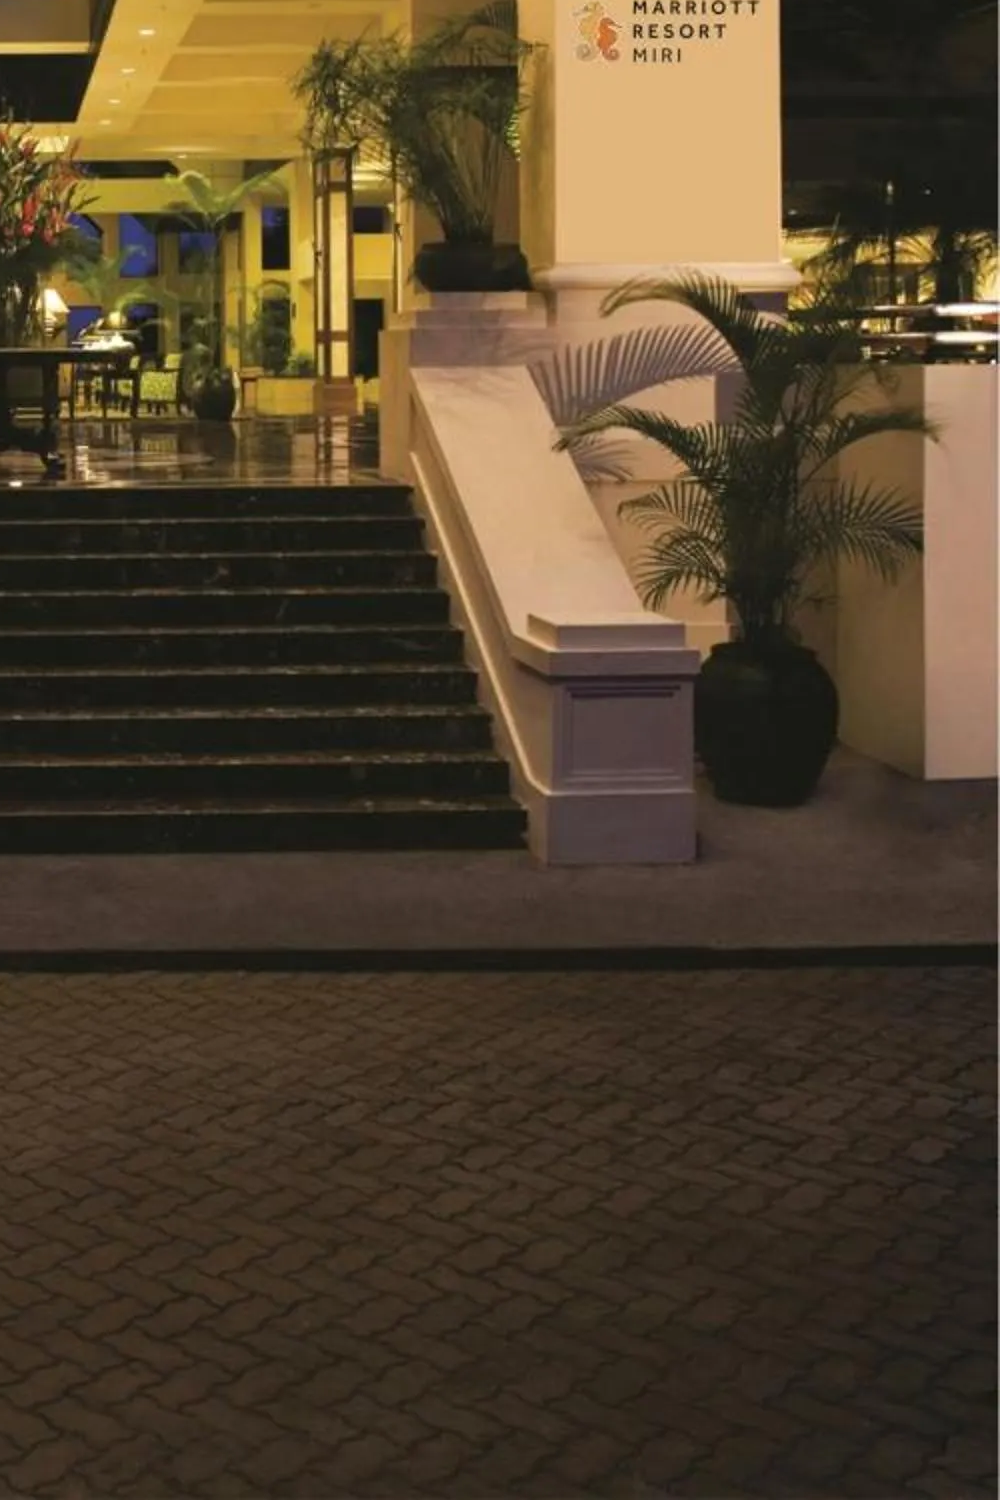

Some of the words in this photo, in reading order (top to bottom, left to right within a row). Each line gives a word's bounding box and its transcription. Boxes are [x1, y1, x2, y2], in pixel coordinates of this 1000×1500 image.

[632, 0, 760, 15] MARRIOTT
[632, 23, 727, 39] RESORT
[632, 47, 682, 63] MIRI
